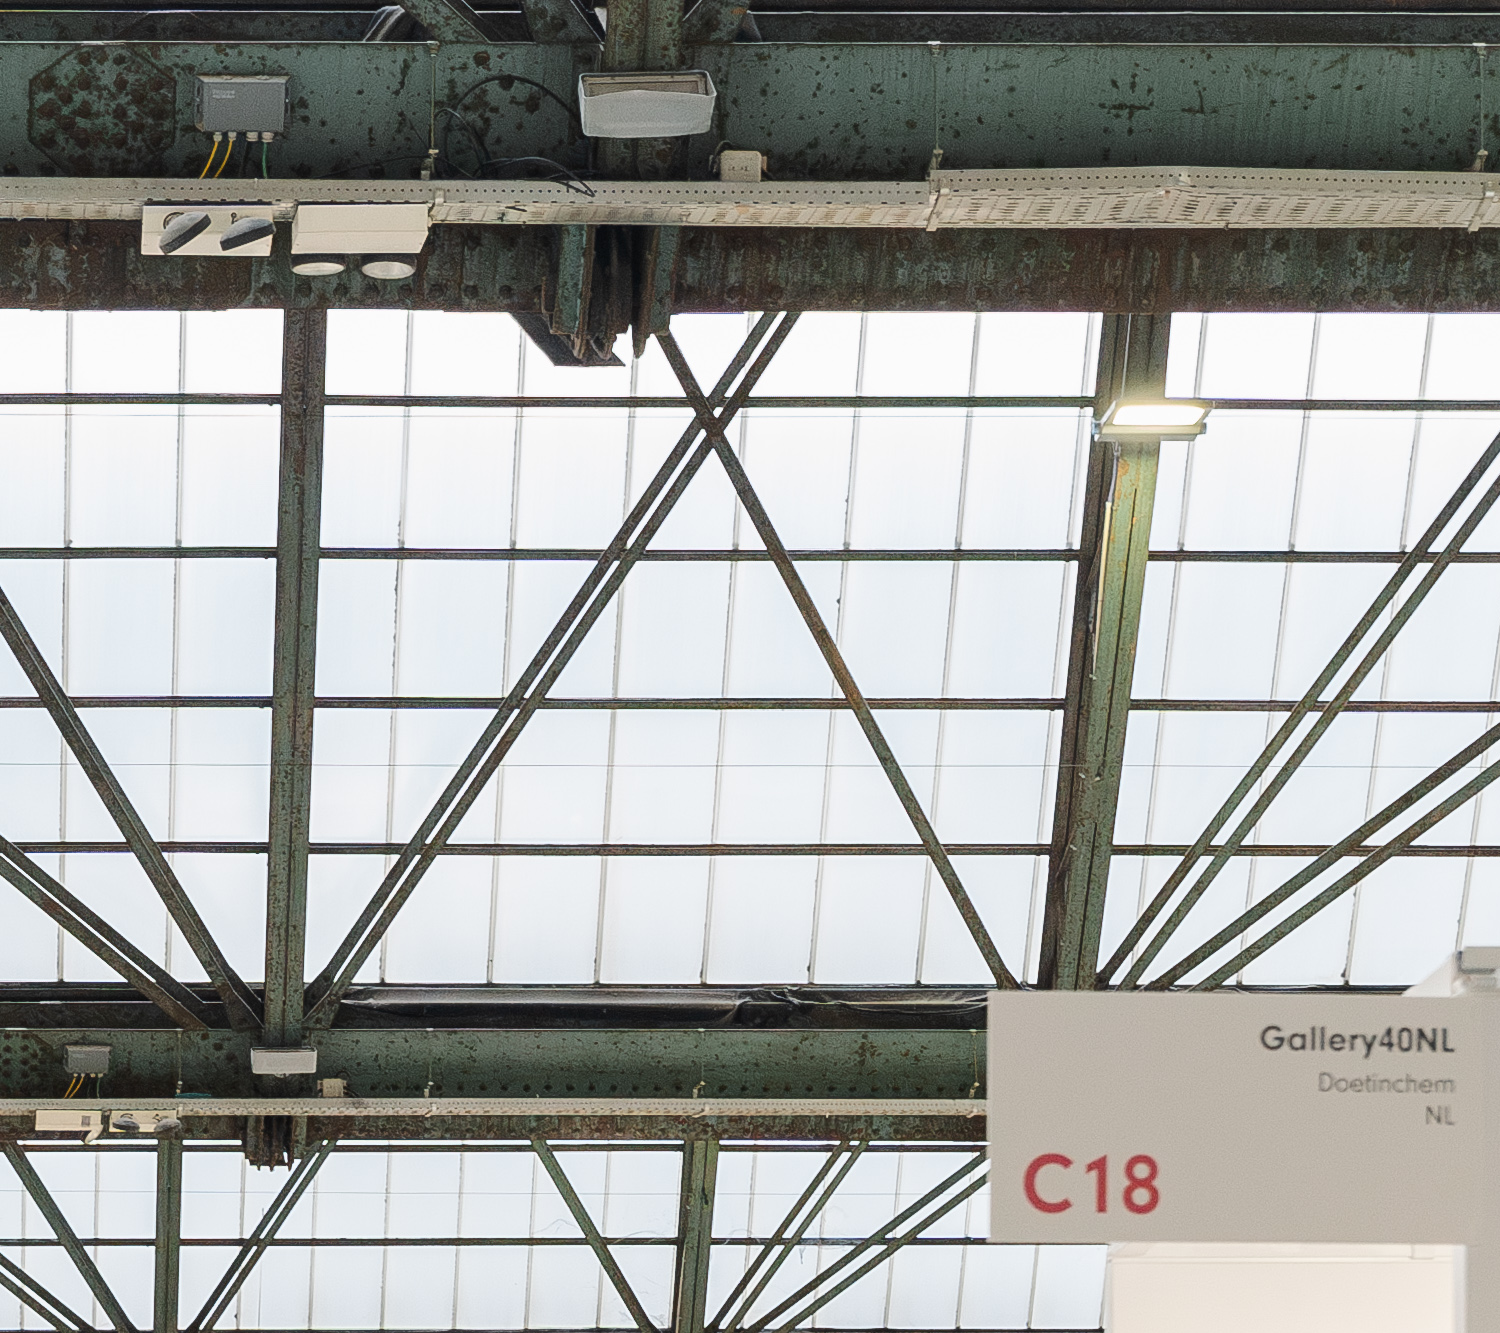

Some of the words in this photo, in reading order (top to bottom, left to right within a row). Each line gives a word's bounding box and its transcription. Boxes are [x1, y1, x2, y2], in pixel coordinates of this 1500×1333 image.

[1260, 1025, 1456, 1059] Gallery40NL
[1317, 1072, 1456, 1094] Doetinchem
[1424, 1106, 1456, 1126] NL
[1022, 1152, 1161, 1215] C18
